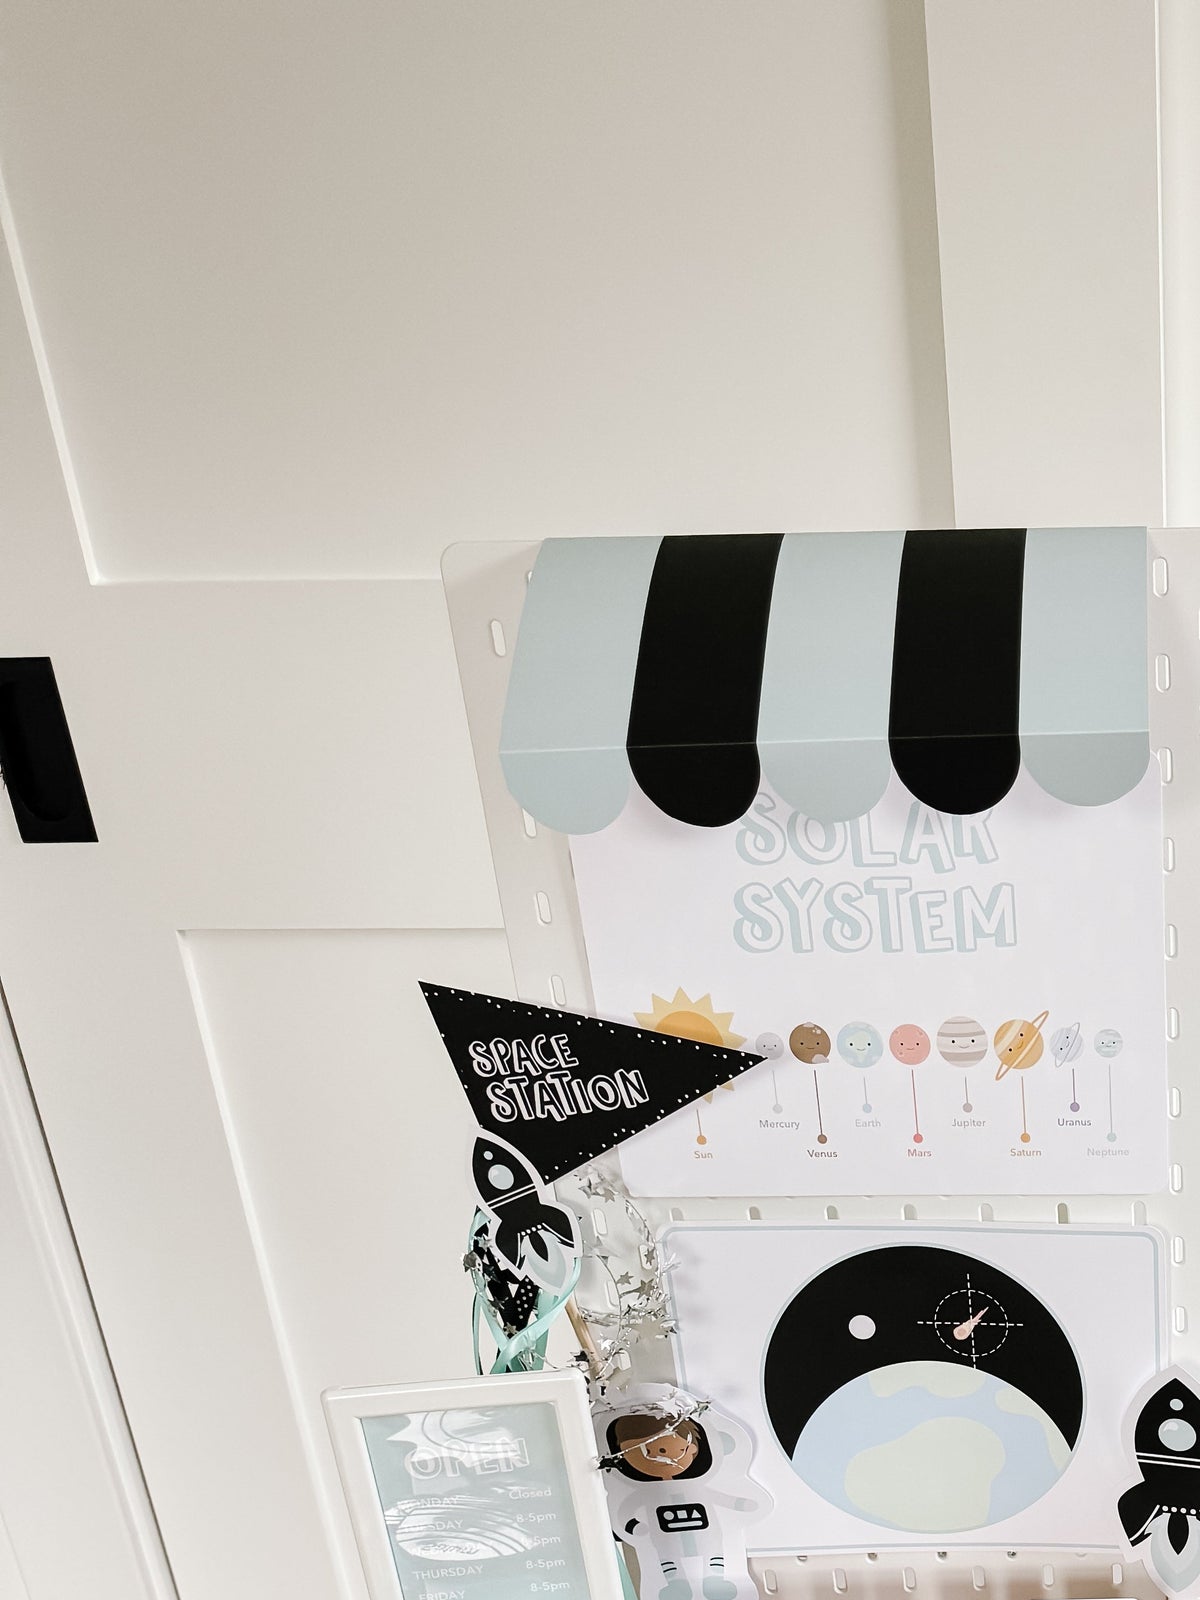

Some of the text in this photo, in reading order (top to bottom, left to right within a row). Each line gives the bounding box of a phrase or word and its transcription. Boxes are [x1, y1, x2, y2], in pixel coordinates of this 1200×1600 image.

[735, 792, 998, 873] SOLAR
[733, 876, 1017, 953] SYSTEM
[468, 1034, 579, 1078] SPACE
[486, 1069, 649, 1122] STATION
[759, 1119, 800, 1131] Mercury
[854, 1118, 881, 1128] Earth
[952, 1117, 986, 1130] Jupiter
[1057, 1117, 1092, 1127] Uranus
[694, 1149, 713, 1159] Sun
[807, 1149, 838, 1159] Venus
[907, 1148, 932, 1158] Mars
[1010, 1147, 1042, 1158] Saturn
[1087, 1147, 1130, 1159] Neptune
[508, 1486, 552, 1500] Closed
[516, 1512, 557, 1524] 8-5pm
[412, 1558, 566, 1581] THURSDAY 8-5pm
[530, 1581, 570, 1593] 8-5pm
